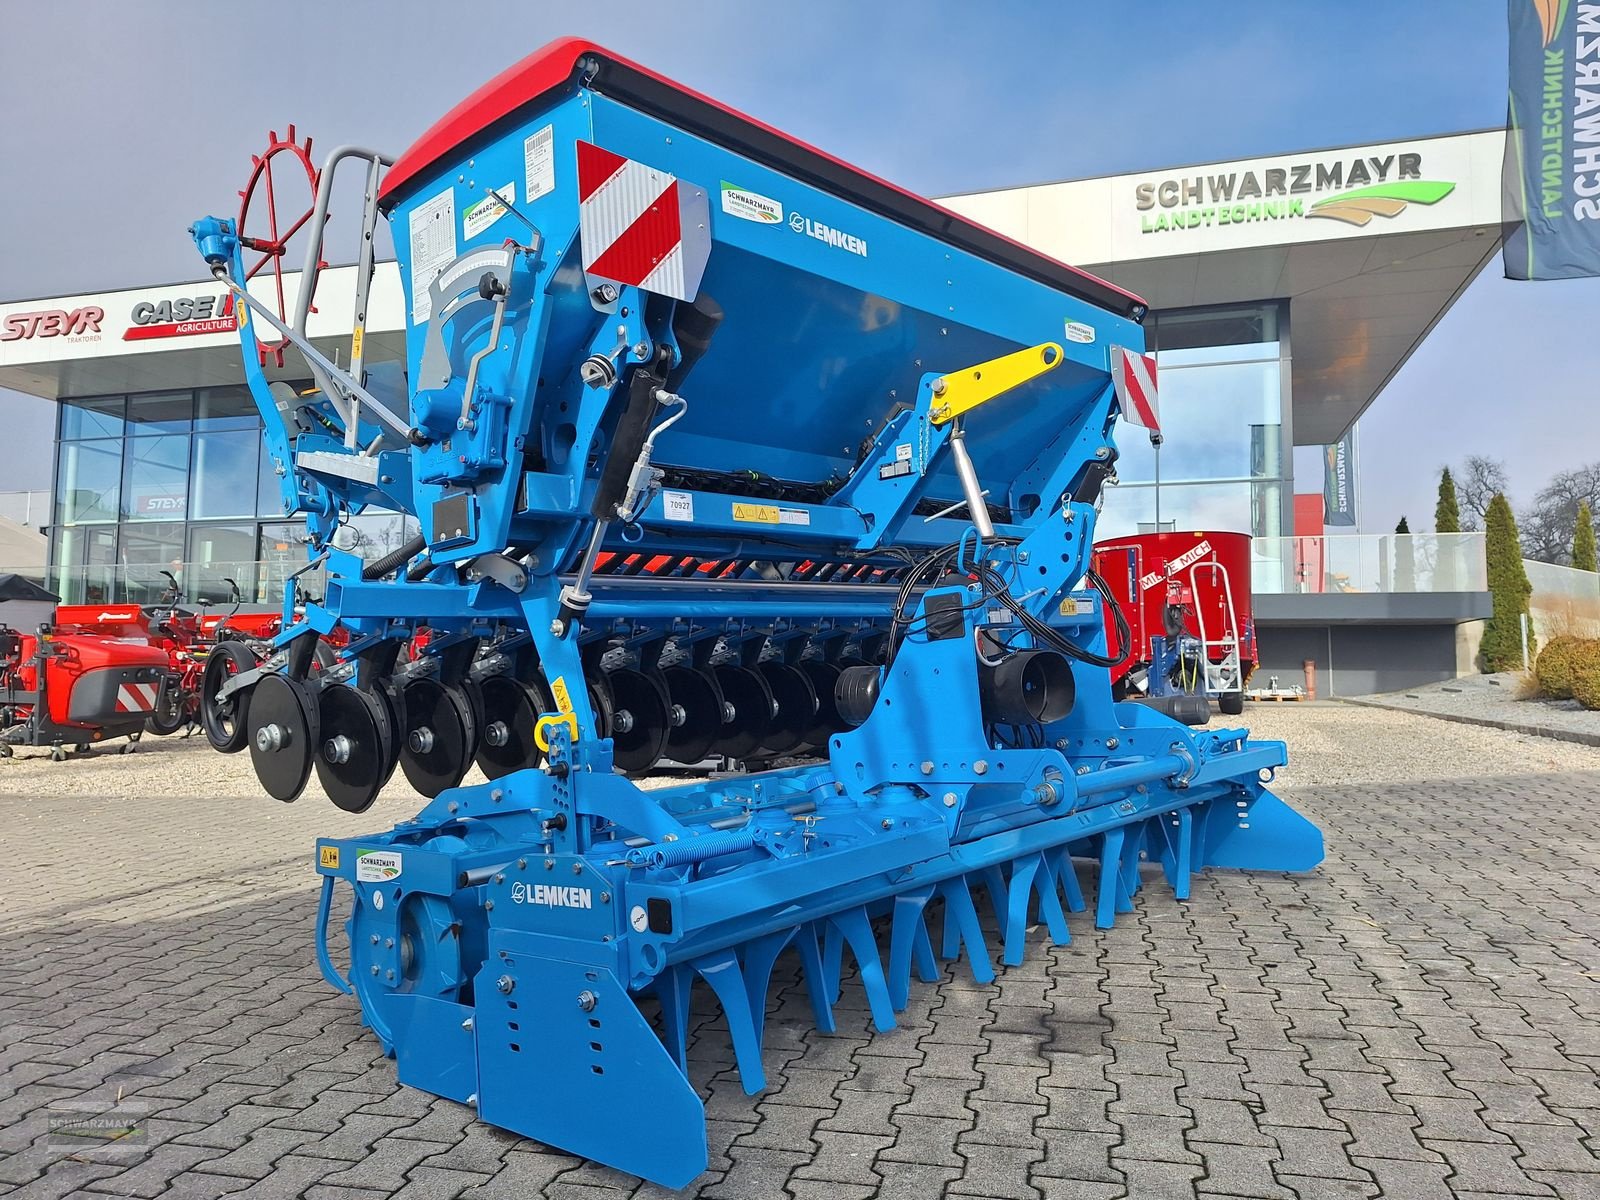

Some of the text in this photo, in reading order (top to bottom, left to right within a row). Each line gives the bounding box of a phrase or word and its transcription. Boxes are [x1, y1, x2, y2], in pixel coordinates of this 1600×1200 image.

[1136, 152, 1422, 211] SCHWARZMAYR
[727, 190, 775, 213] SCHWARZMAYR
[1141, 199, 1304, 234] LANDTECHNIK
[805, 218, 868, 258] LEMKEN
[131, 295, 216, 325] CASE
[0, 305, 104, 342] STEYR
[176, 319, 233, 333] AGRICULTURE
[67, 335, 102, 344] TRAKTOREN
[670, 500, 690, 510] 70927
[1179, 542, 1210, 567] MICH
[360, 857, 396, 867] SCHWARZMAYR
[526, 884, 592, 910] LEMKEN
